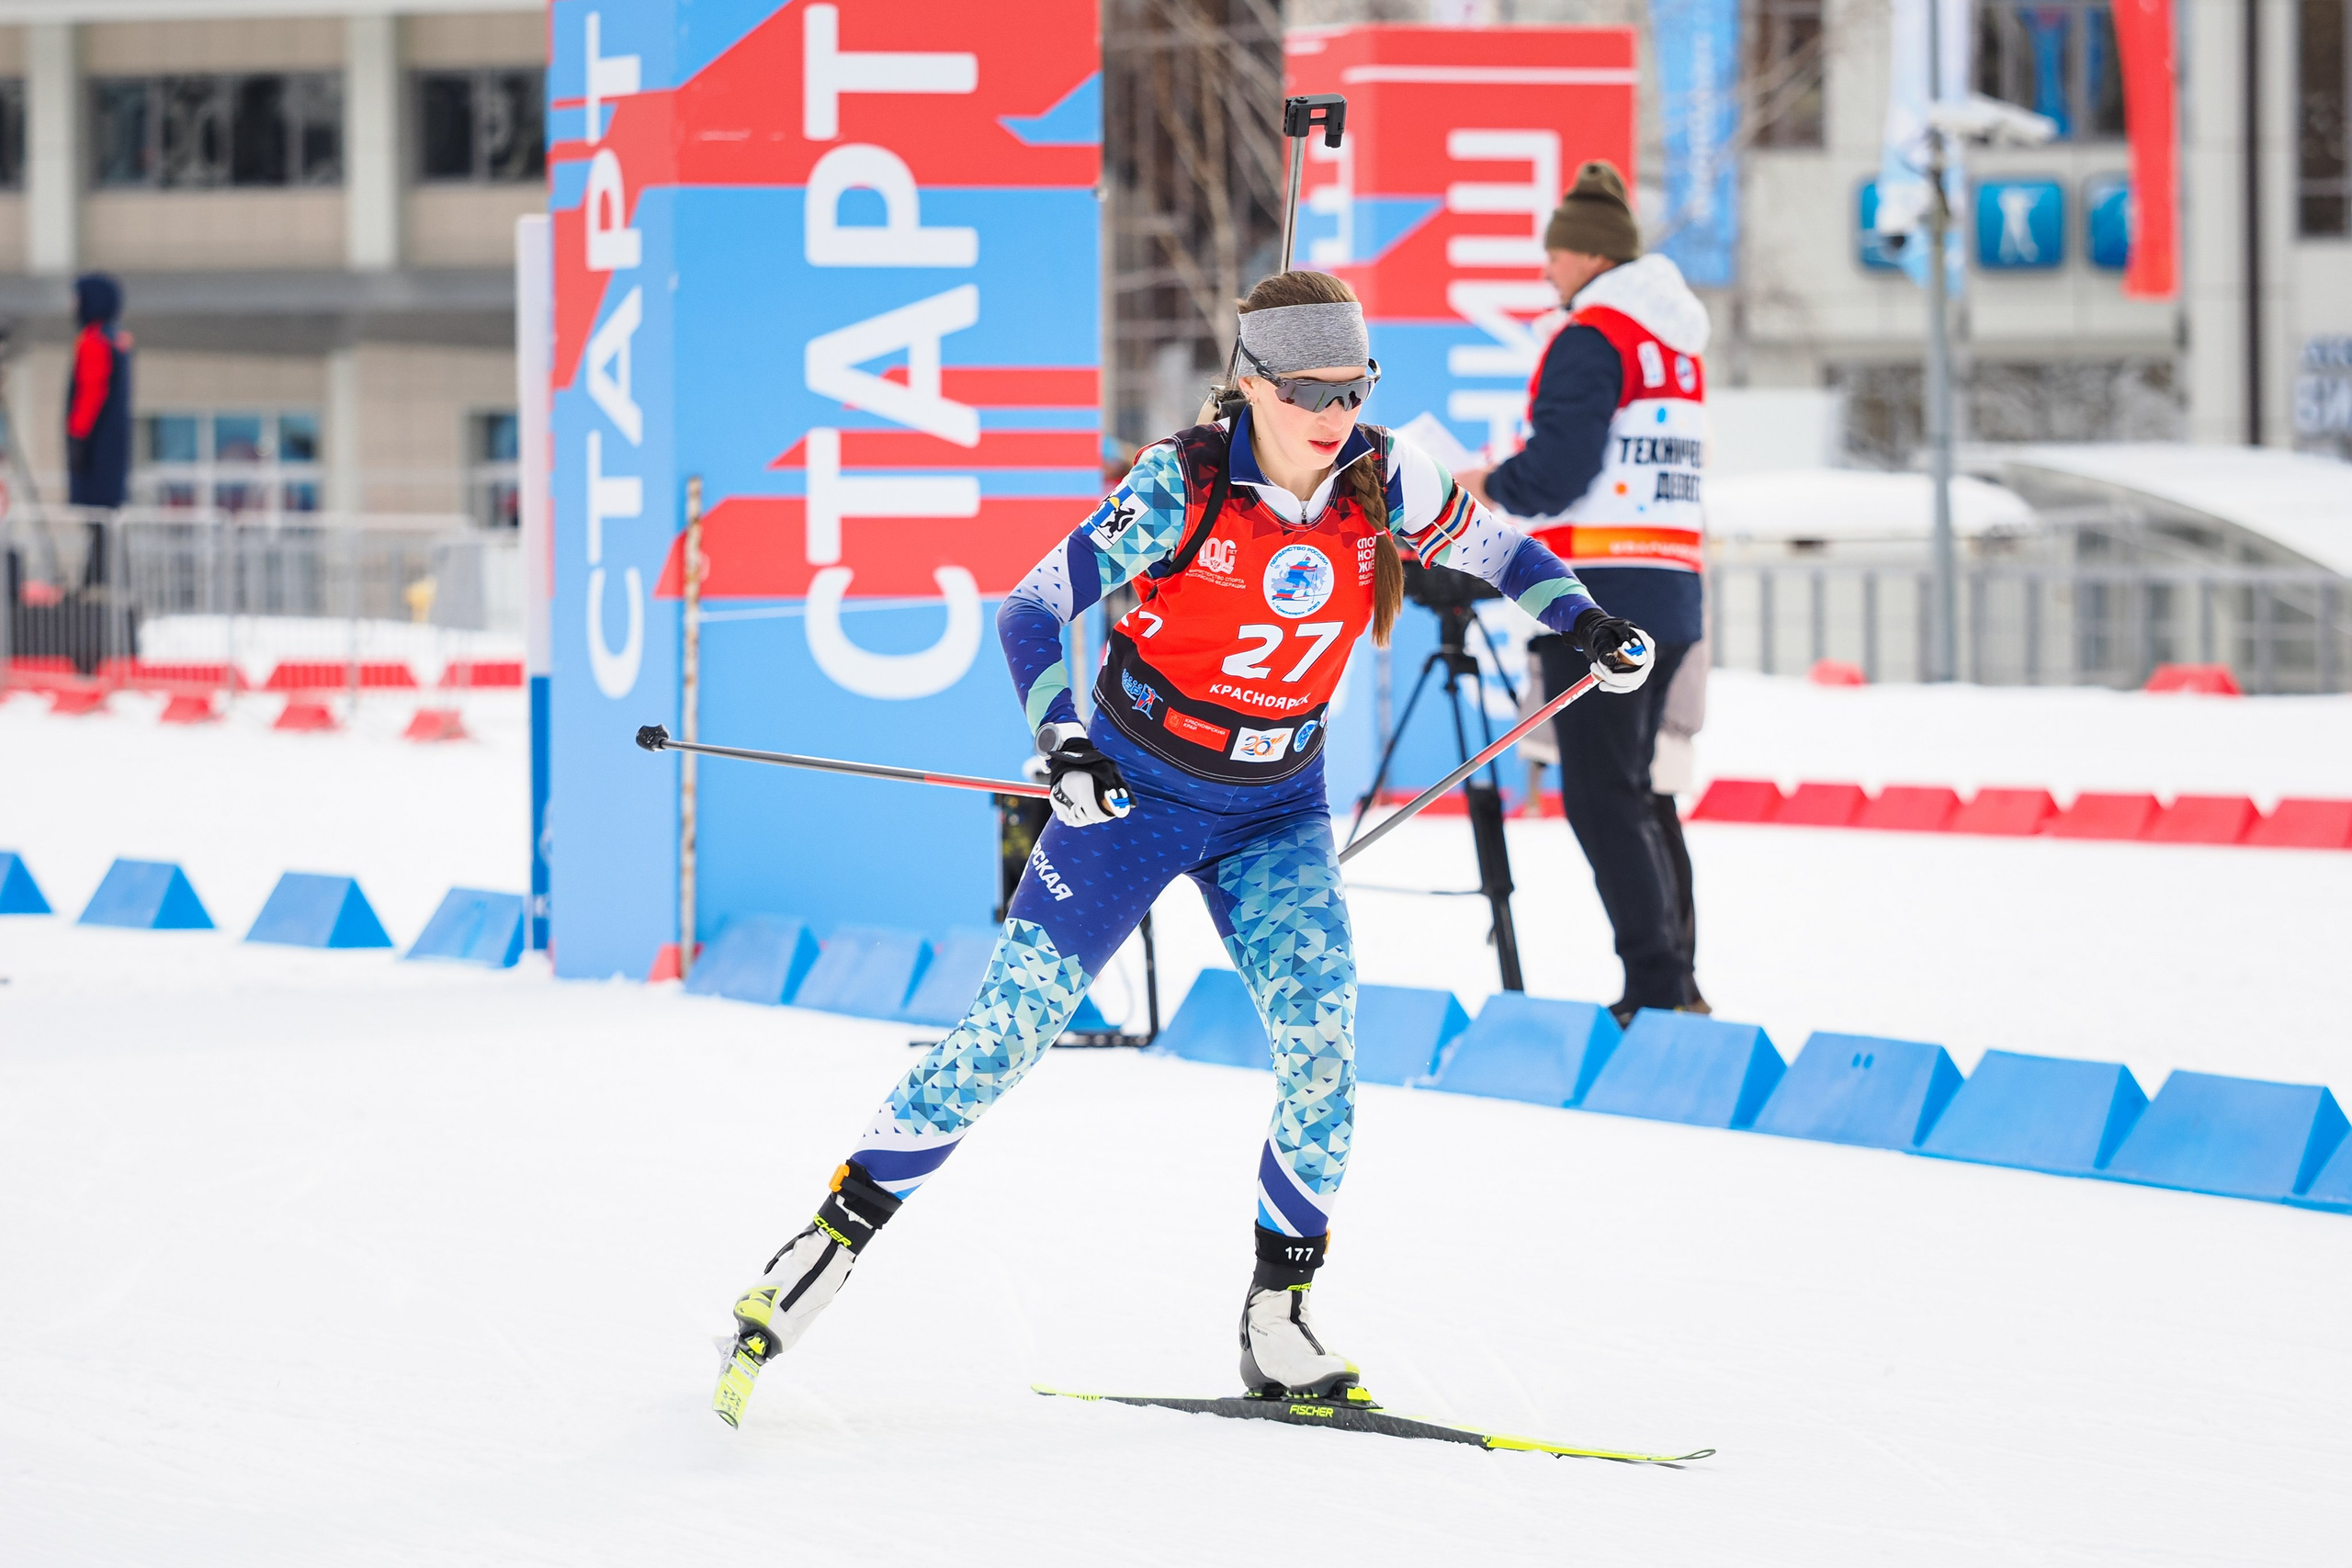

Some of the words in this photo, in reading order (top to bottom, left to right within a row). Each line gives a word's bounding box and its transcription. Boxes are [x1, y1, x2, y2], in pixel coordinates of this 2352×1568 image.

[586, 11, 642, 700] СТАРТ
[803, 3, 981, 701] СТАРТ
[1270, 546, 1306, 568] ПЕРВЕНСТВО
[1306, 547, 1329, 566] РОССИИ
[1188, 569, 1225, 581] МИНИСТЕРСТВО
[1224, 576, 1245, 584] СПОРТА
[1221, 621, 1345, 682] 27
[1209, 683, 1312, 710] КРАСНОЯРСК
[1182, 722, 1198, 731] КРАЙ
[1184, 718, 1227, 736] КРАСНОЯРСКИЙ
[1284, 1247, 1314, 1262] 177
[1289, 1404, 1334, 1418] FISCHER
